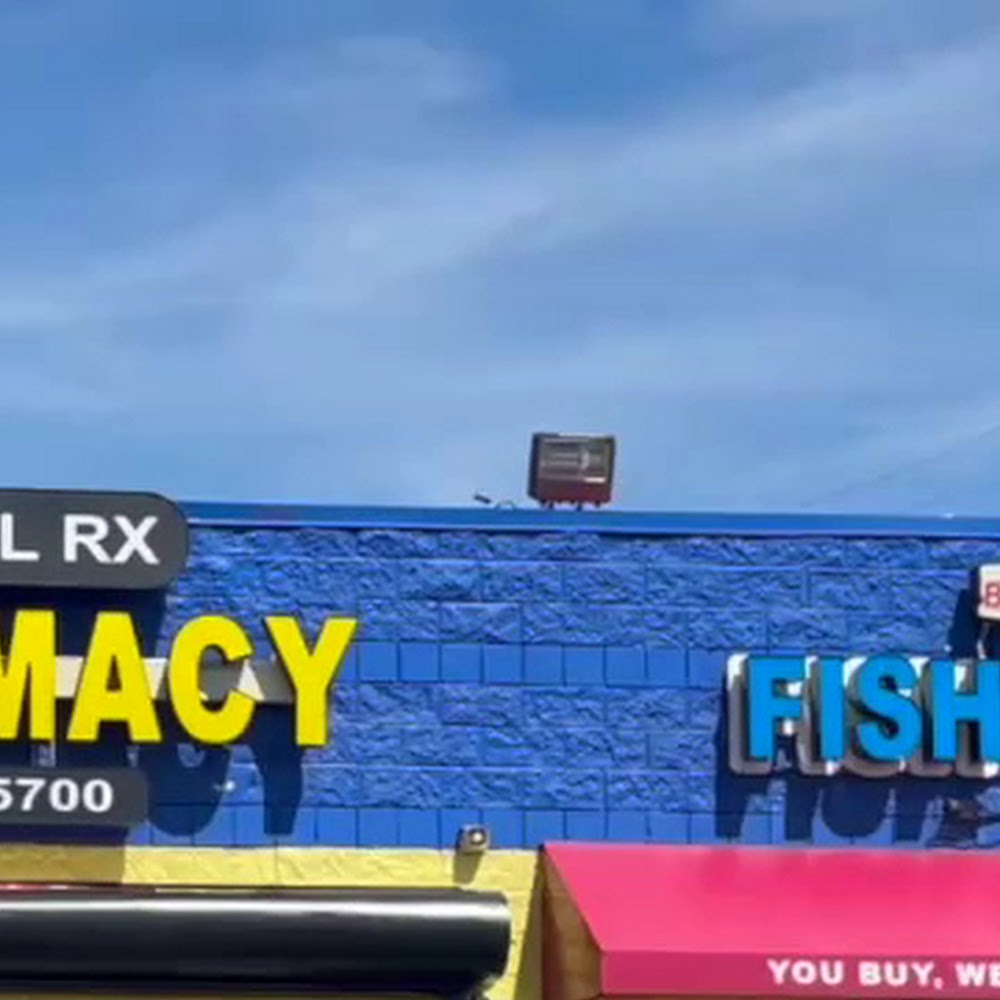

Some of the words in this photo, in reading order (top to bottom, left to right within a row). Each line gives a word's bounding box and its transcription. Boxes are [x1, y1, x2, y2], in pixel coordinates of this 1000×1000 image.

[62, 513, 160, 566] RX
[748, 654, 1000, 762] FISH
[767, 960, 844, 986] YOU
[858, 960, 943, 990] BUY,
[955, 961, 1000, 988] WE
